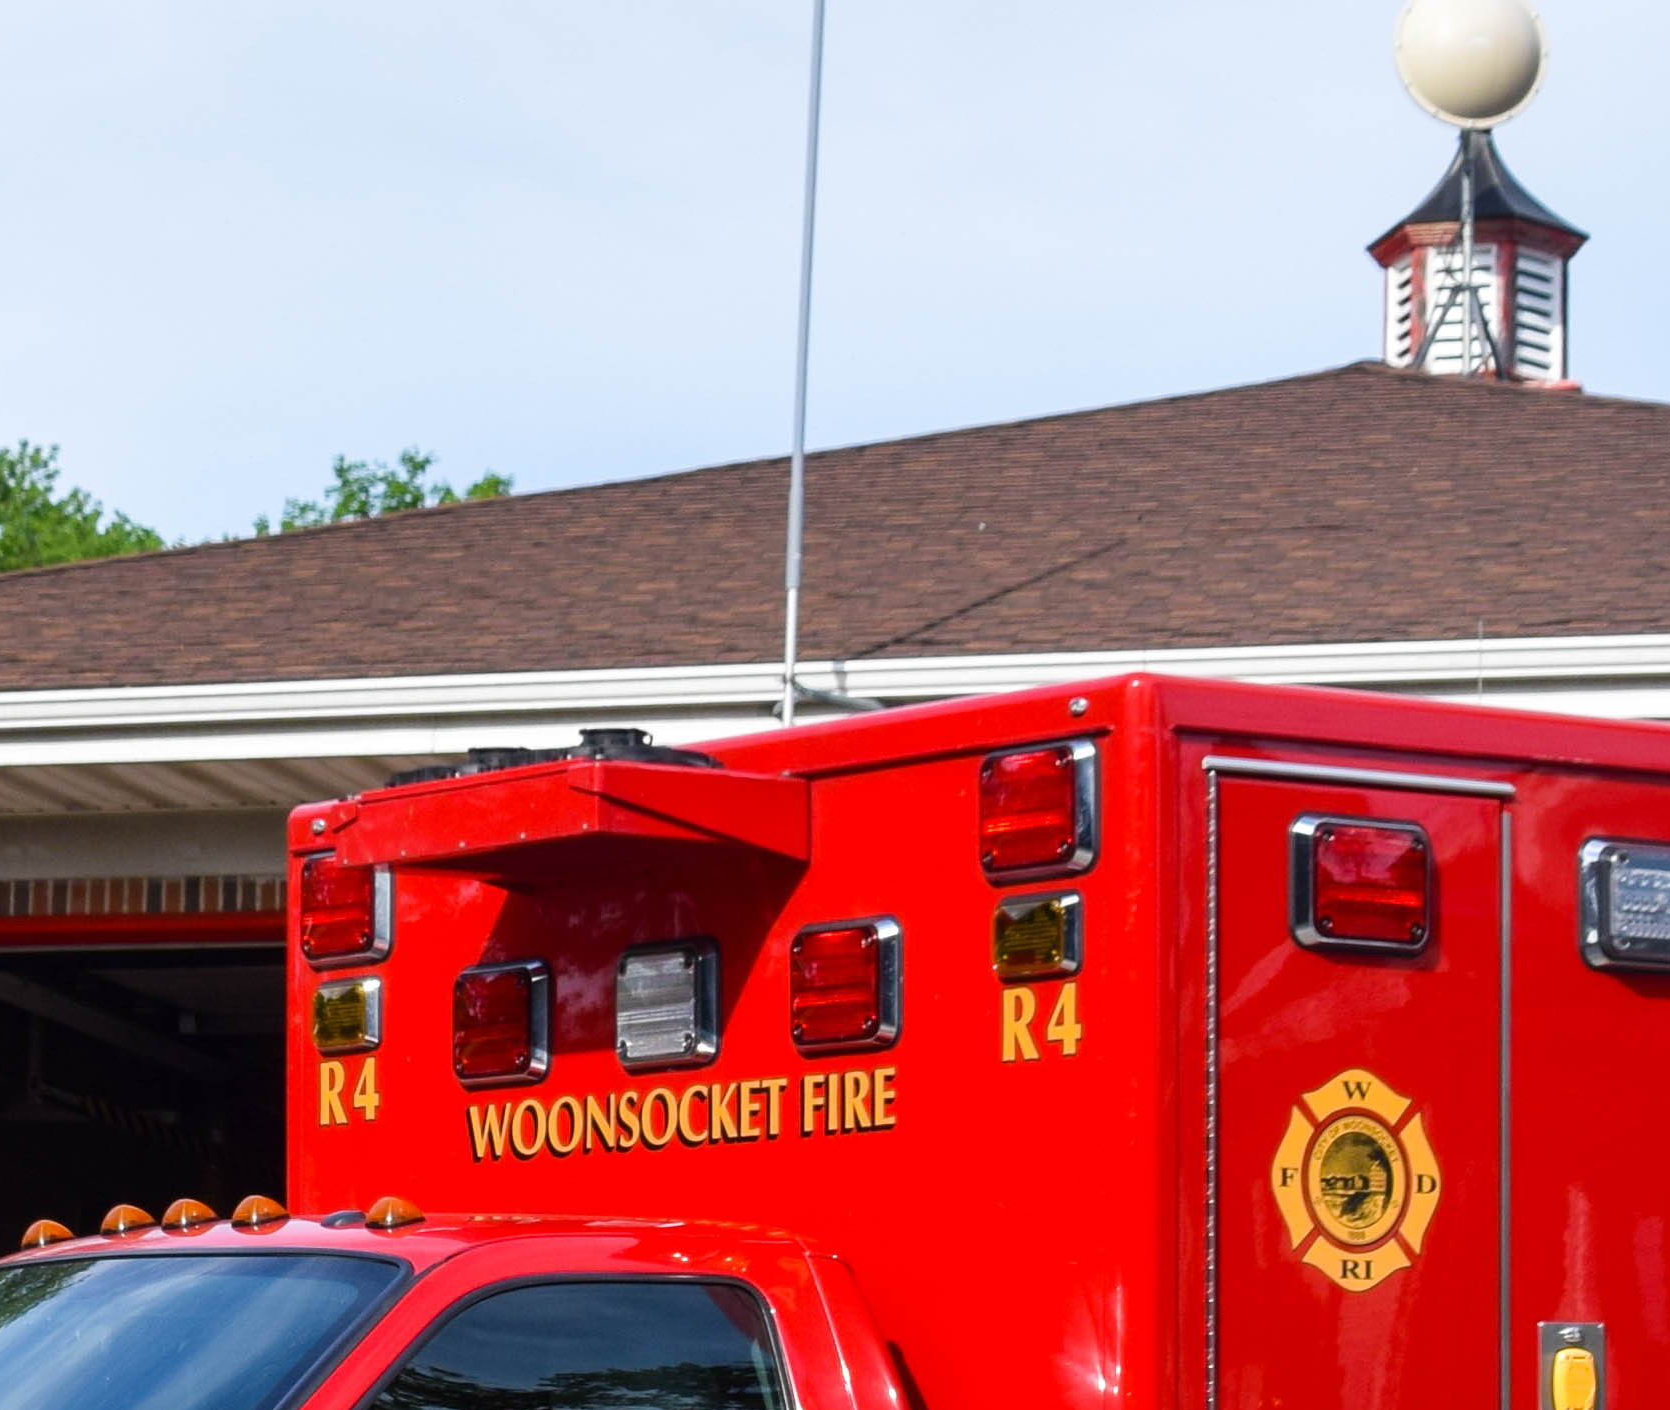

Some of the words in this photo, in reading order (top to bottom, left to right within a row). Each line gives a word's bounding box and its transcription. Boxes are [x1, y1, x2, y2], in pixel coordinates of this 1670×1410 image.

[1000, 982, 1084, 1064] R4
[318, 1057, 381, 1126] R4
[1342, 1080, 1372, 1100] W
[466, 1077, 789, 1163] WOONSOCKET
[802, 1067, 898, 1134] FIRE
[1279, 1167, 1299, 1188] F
[1415, 1173, 1438, 1195] D
[1340, 1259, 1374, 1281] RI
